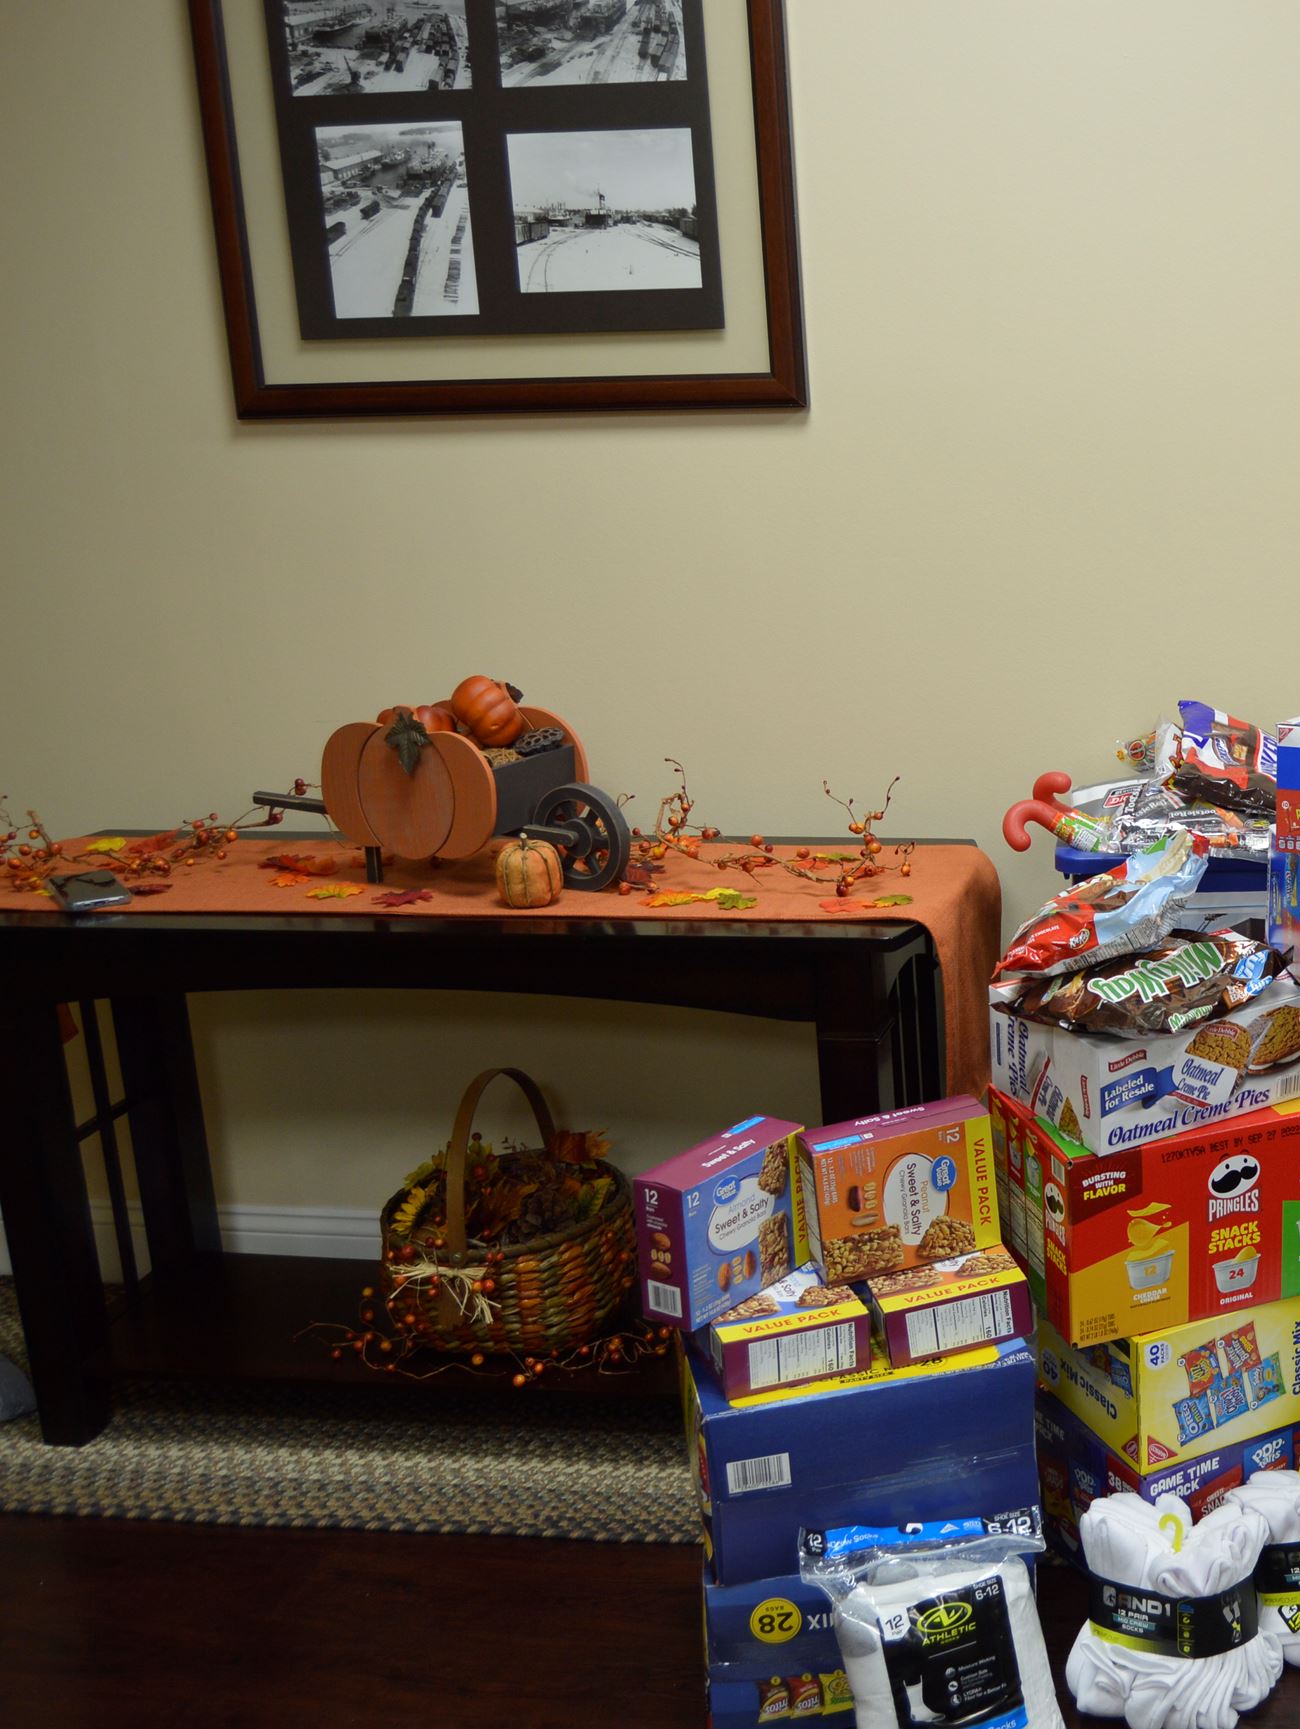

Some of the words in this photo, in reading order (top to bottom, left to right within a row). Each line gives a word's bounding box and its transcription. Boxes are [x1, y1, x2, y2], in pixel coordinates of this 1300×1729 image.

[1007, 1016, 1017, 1058] reme
[1018, 1021, 1030, 1095] Oatmeal
[1111, 1058, 1126, 1071] Little
[1126, 1051, 1146, 1067] Debbie
[1182, 1058, 1221, 1086] Oatmeal
[1105, 1075, 1143, 1100] Labeled
[1105, 1095, 1120, 1110] for
[1122, 1081, 1155, 1103] Resale
[1178, 1078, 1200, 1097] Creme
[1108, 1115, 1178, 1146] Oatmeal
[1181, 1101, 1230, 1125] Creme
[1234, 1087, 1270, 1110] Pies
[946, 1126, 960, 1144] 12
[1248, 1134, 1263, 1146] SEP
[973, 1137, 984, 1182] VALUE
[906, 1162, 917, 1199] Sweet
[941, 1158, 951, 1186] Great
[1082, 1171, 1126, 1188] BURSTING
[644, 1188, 659, 1205] 12
[715, 1180, 737, 1198] Great
[920, 1179, 930, 1214] Peanut
[1083, 1183, 1126, 1201] FLAVOR
[1095, 1180, 1115, 1190] WITH
[686, 1191, 700, 1209] 12
[977, 1186, 992, 1227] PACK
[1208, 1190, 1260, 1223] PRINGLES
[714, 1211, 741, 1234] Sweet
[742, 1208, 749, 1220] &
[749, 1197, 770, 1217] Salty
[794, 1199, 806, 1243] VALUE
[909, 1207, 922, 1236] Salty
[1045, 1209, 1065, 1248] PRINGLES
[1211, 1221, 1259, 1243] SNACK
[1047, 1238, 1066, 1264] SNACK
[1208, 1232, 1261, 1254] STACKS
[1046, 1247, 1068, 1276] STACKS
[1229, 1267, 1245, 1280] 24
[904, 1287, 952, 1304] VALUE
[958, 1275, 1001, 1293] PACK
[1133, 1287, 1168, 1302] CHEDDAR
[1220, 1292, 1253, 1305] ORIGINAL
[1002, 1290, 1010, 1314] Nutrition
[743, 1318, 791, 1335] VALUE
[797, 1308, 841, 1324] PACK
[1005, 1316, 1013, 1334] Facts
[1150, 1345, 1160, 1366] 40
[1060, 1358, 1079, 1384] Mix
[1080, 1378, 1118, 1420] Classic
[1182, 1403, 1199, 1433] OREO
[1107, 1471, 1122, 1493] 38
[1150, 1471, 1184, 1496] GAME
[1187, 1456, 1220, 1479] TIME
[987, 1516, 1032, 1536] 6-12
[807, 1532, 823, 1548] 12
[975, 1584, 1000, 1601] 6-12
[758, 1611, 794, 1634] 28
[807, 1613, 834, 1631] IX
[885, 1614, 905, 1631] 12
[1117, 1608, 1127, 1616] 12
[1127, 1611, 1149, 1622] PAIR
[921, 1622, 977, 1647] ATHLETIC
[1121, 1623, 1144, 1633] SOCKS
